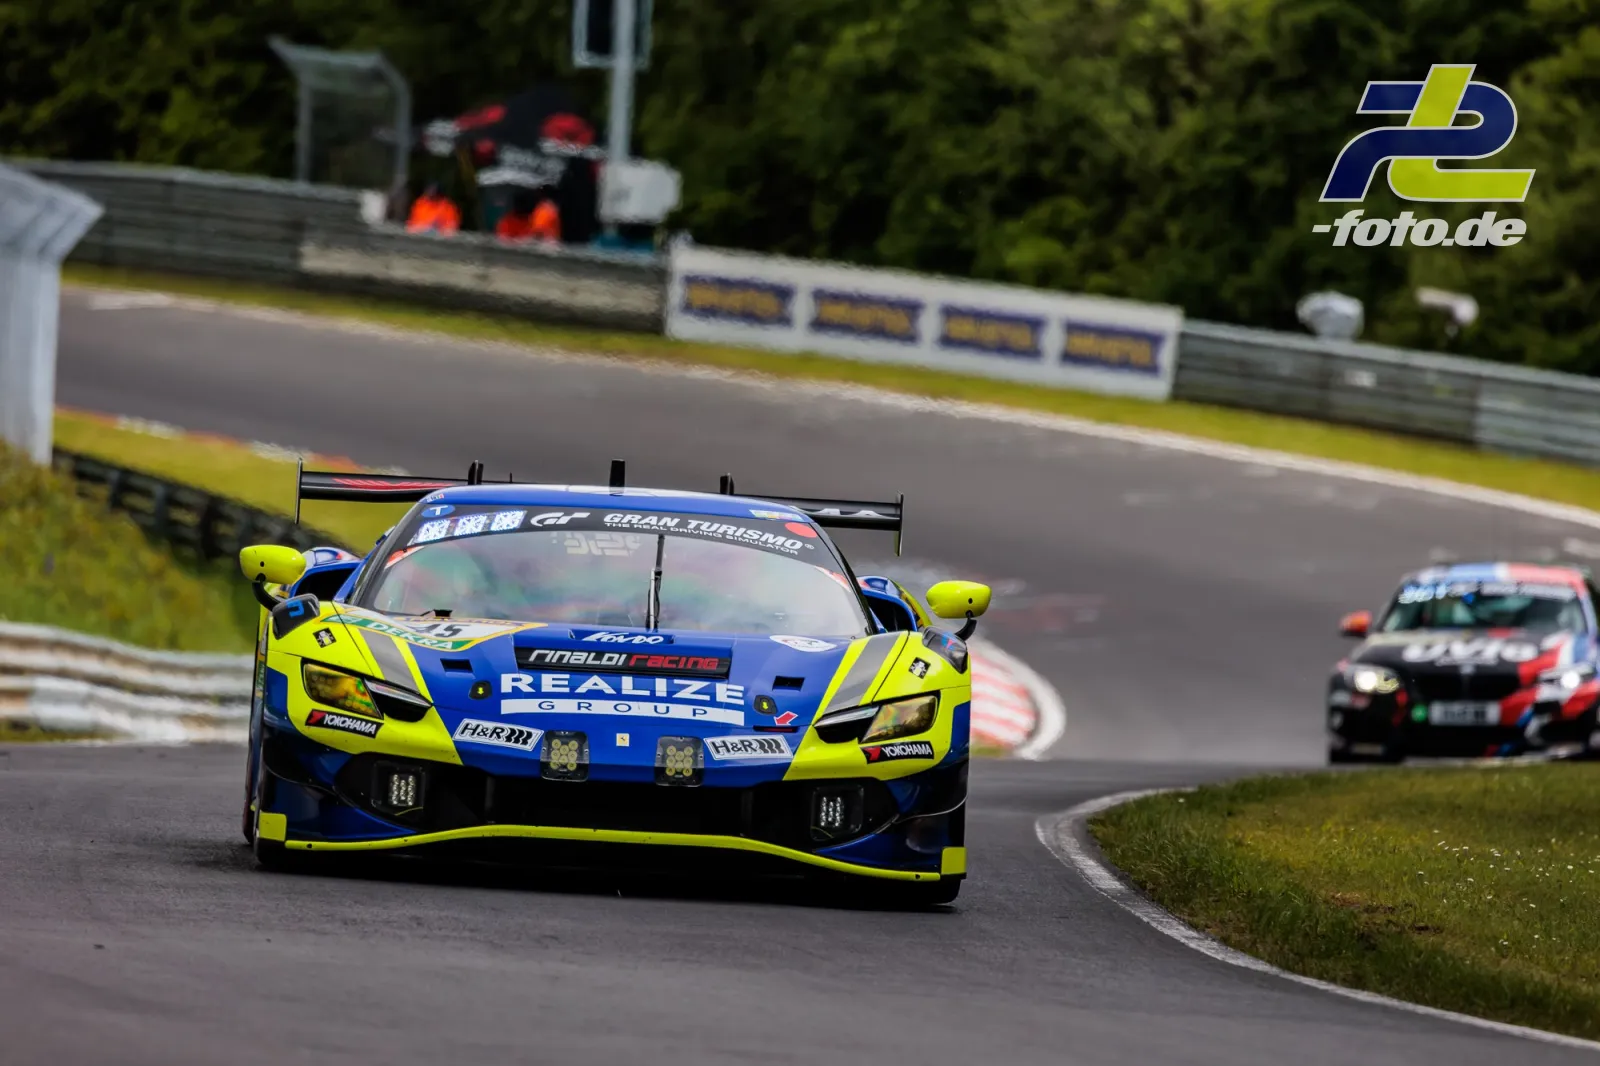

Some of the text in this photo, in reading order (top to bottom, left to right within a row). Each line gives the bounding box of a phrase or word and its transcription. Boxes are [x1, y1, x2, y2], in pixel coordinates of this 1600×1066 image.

[530, 512, 591, 527] GT
[603, 513, 680, 527] GRAN
[670, 526, 722, 538] DRIVING
[725, 535, 799, 555] SIMULATOR
[366, 621, 453, 649] DEKRA
[500, 673, 745, 705] REALIZE
[537, 700, 708, 717] GROUP
[323, 713, 378, 735] YOKOHAMA
[460, 722, 505, 738] H&R
[711, 738, 760, 755] H&R
[881, 743, 933, 757] YOKOHAMA
